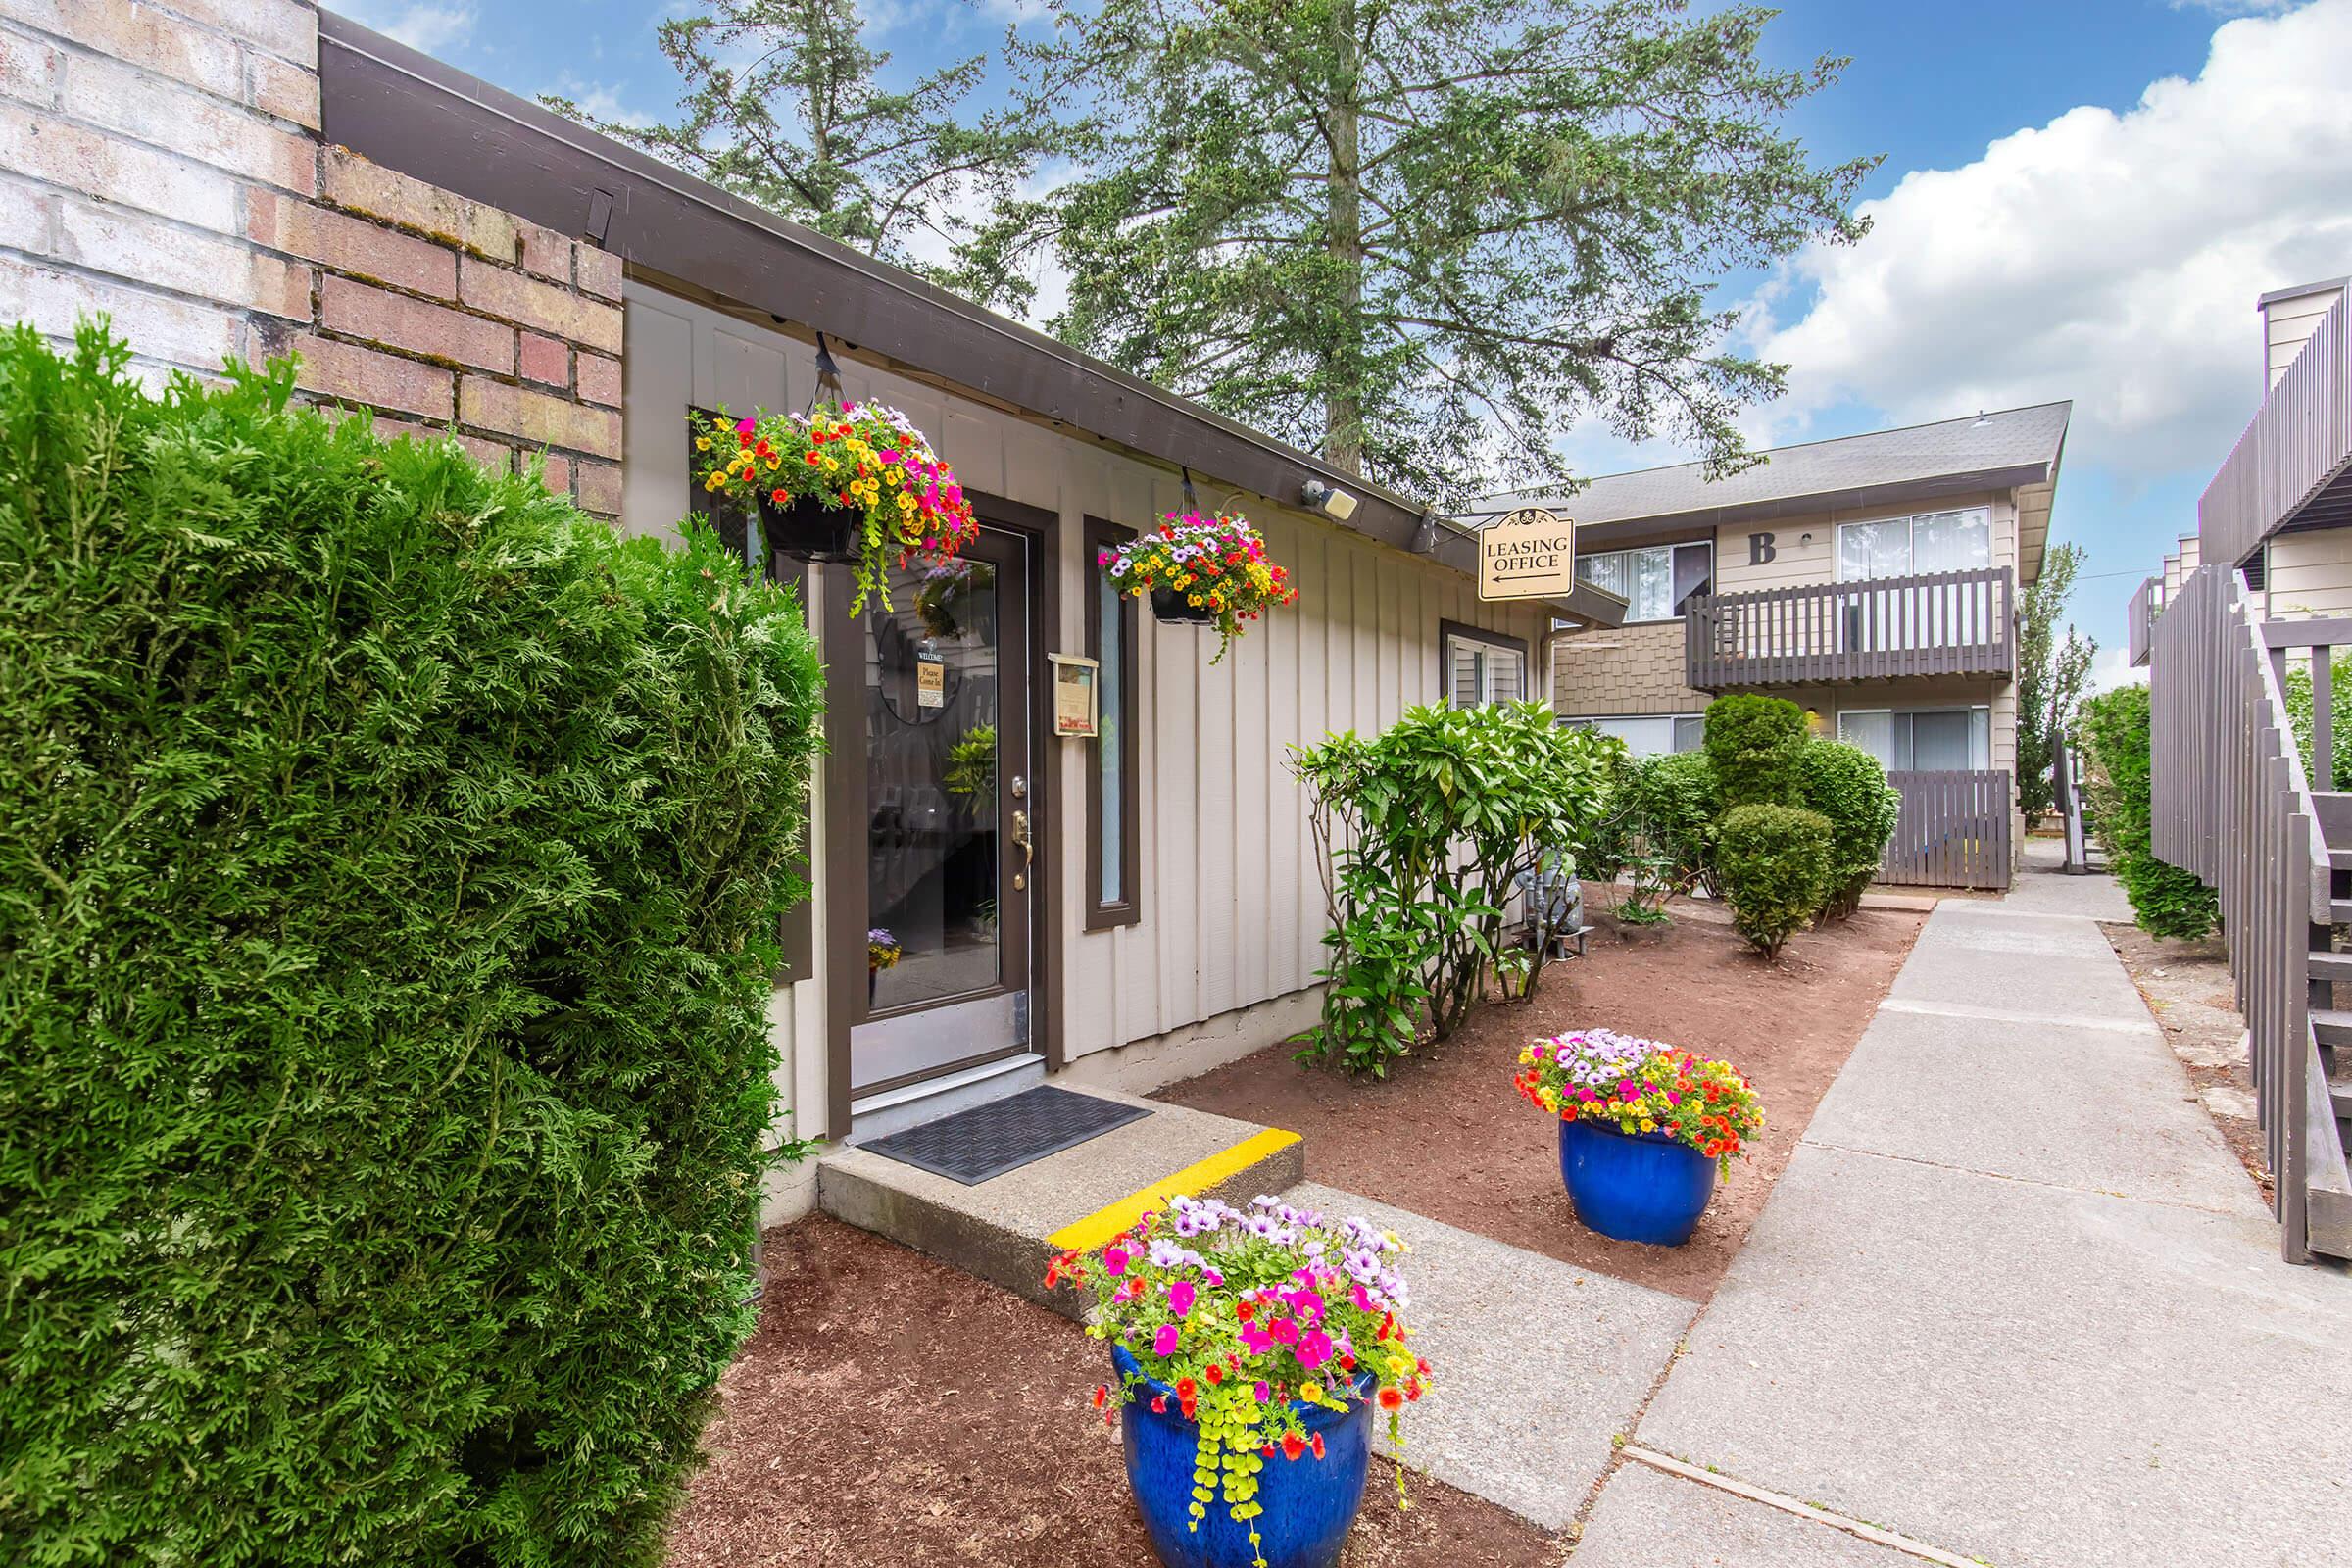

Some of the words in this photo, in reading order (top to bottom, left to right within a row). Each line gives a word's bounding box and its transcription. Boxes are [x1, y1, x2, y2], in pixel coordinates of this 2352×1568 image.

[1487, 537, 1568, 557] LEASING
[1748, 532, 1776, 565] B
[1494, 555, 1559, 571] OFFICE
